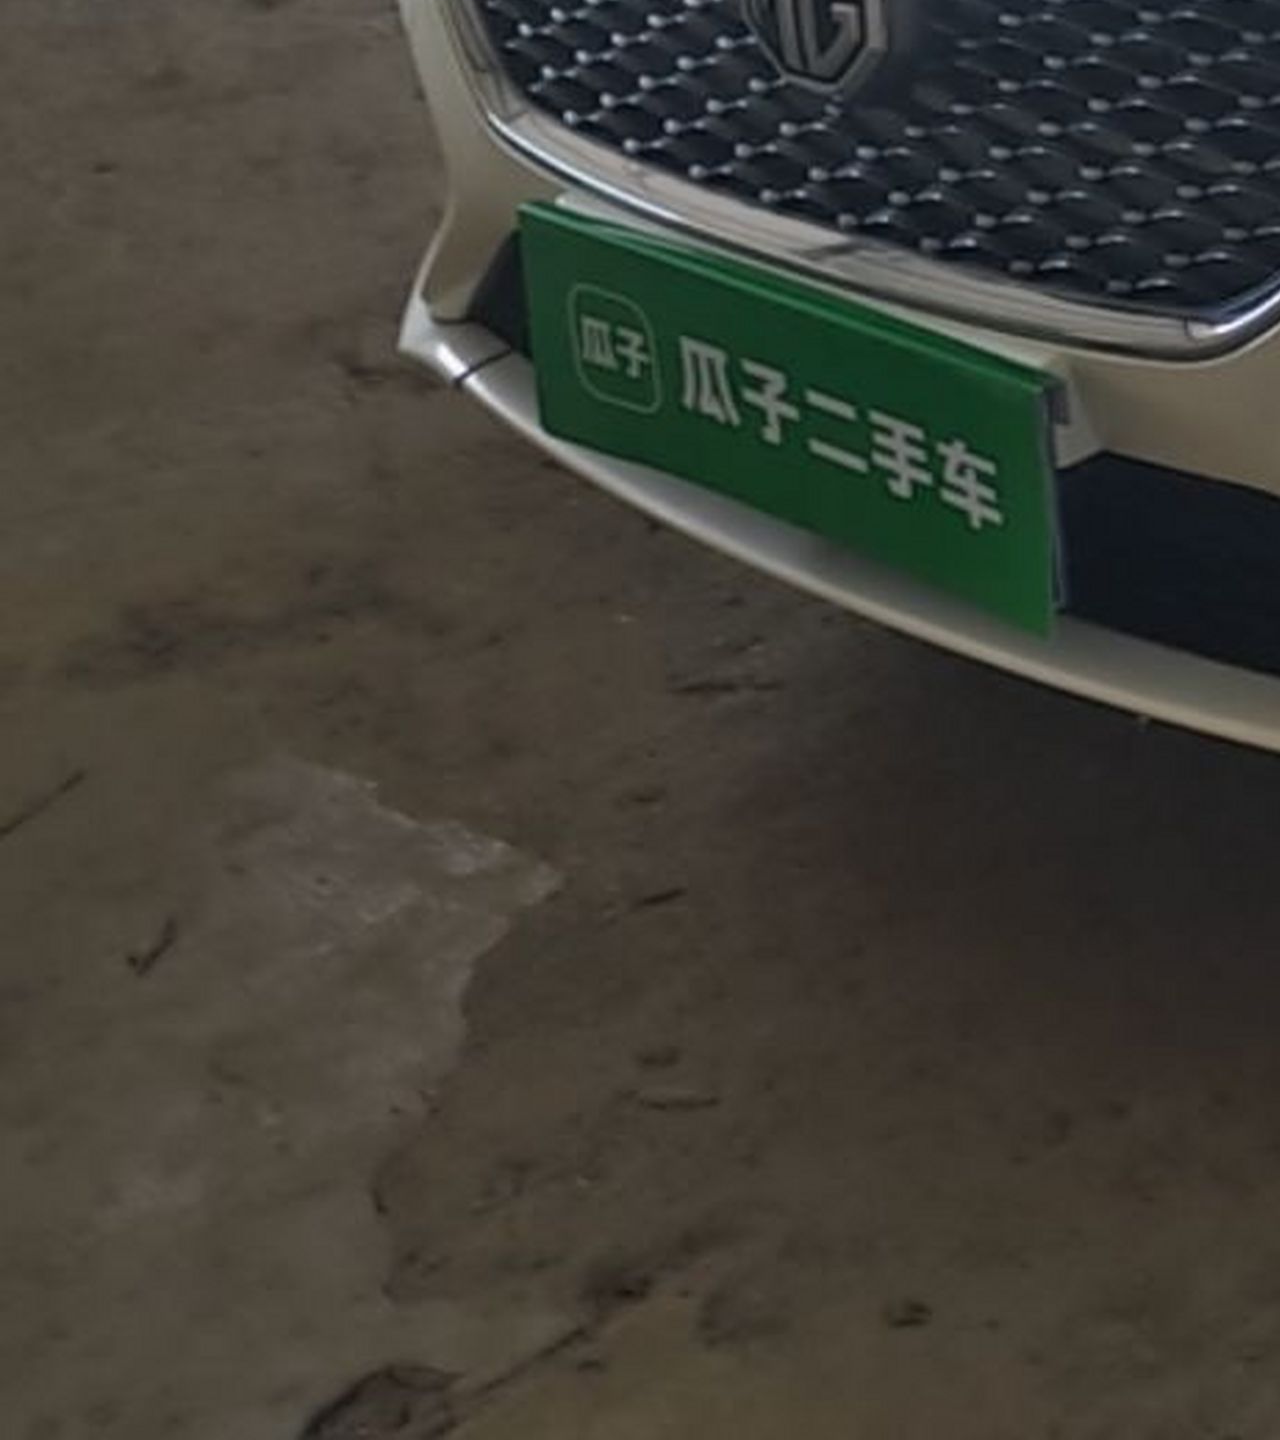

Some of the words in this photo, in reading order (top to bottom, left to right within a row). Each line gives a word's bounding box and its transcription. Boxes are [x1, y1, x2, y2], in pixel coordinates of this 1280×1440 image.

[580, 314, 650, 378] 瓜子
[679, 335, 1003, 529] 瓜子二手车
